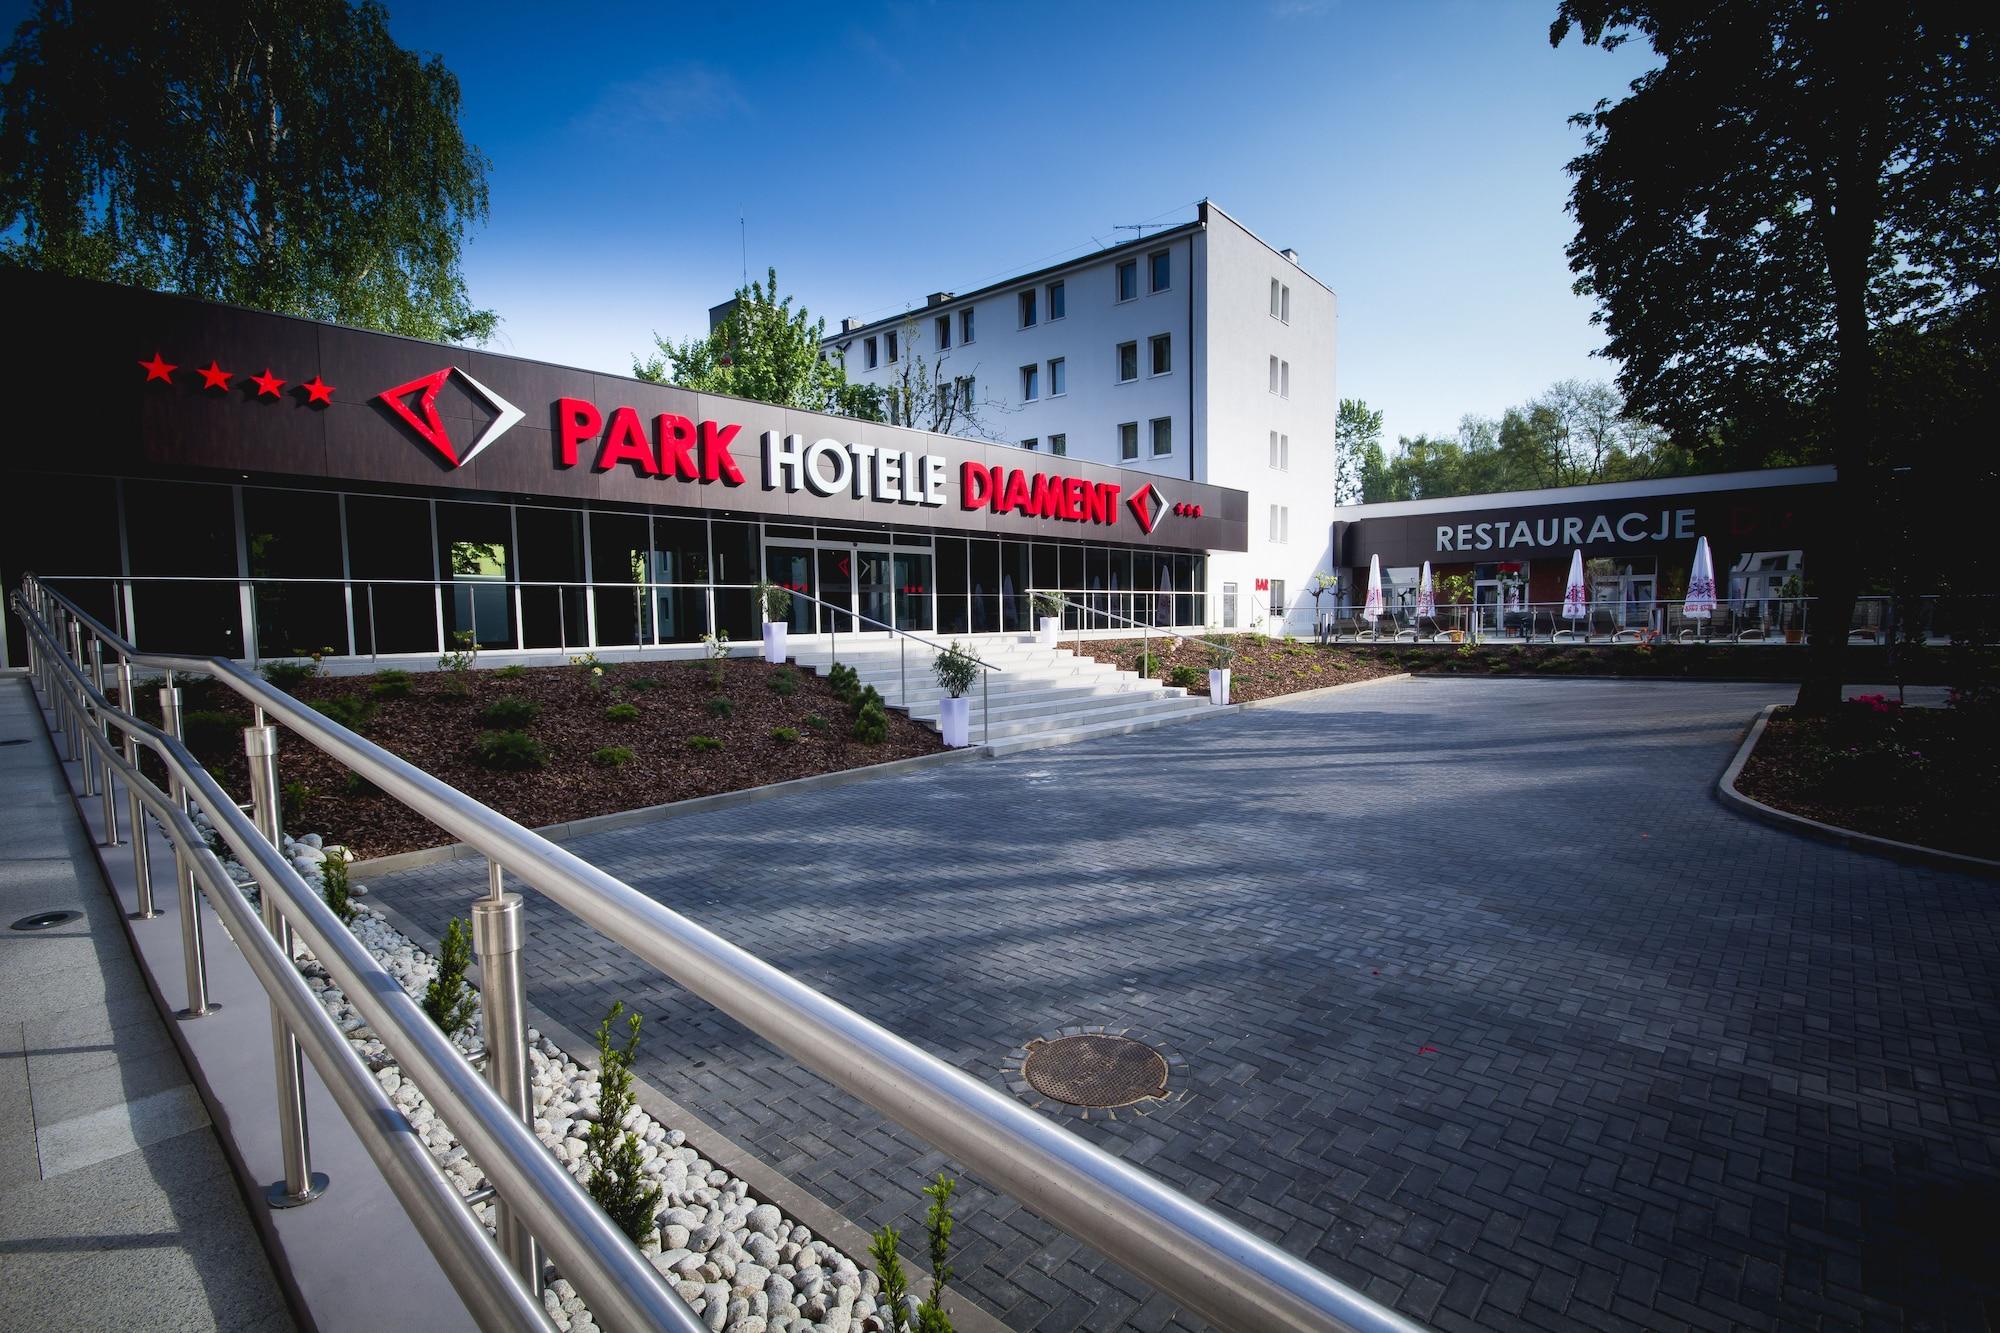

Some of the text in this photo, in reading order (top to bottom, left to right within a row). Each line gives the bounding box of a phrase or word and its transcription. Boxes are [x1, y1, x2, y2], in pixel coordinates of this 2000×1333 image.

[556, 397, 1121, 524] PARK HOTELE DIAMENT
[1436, 509, 1696, 552] RESTAURACJE
